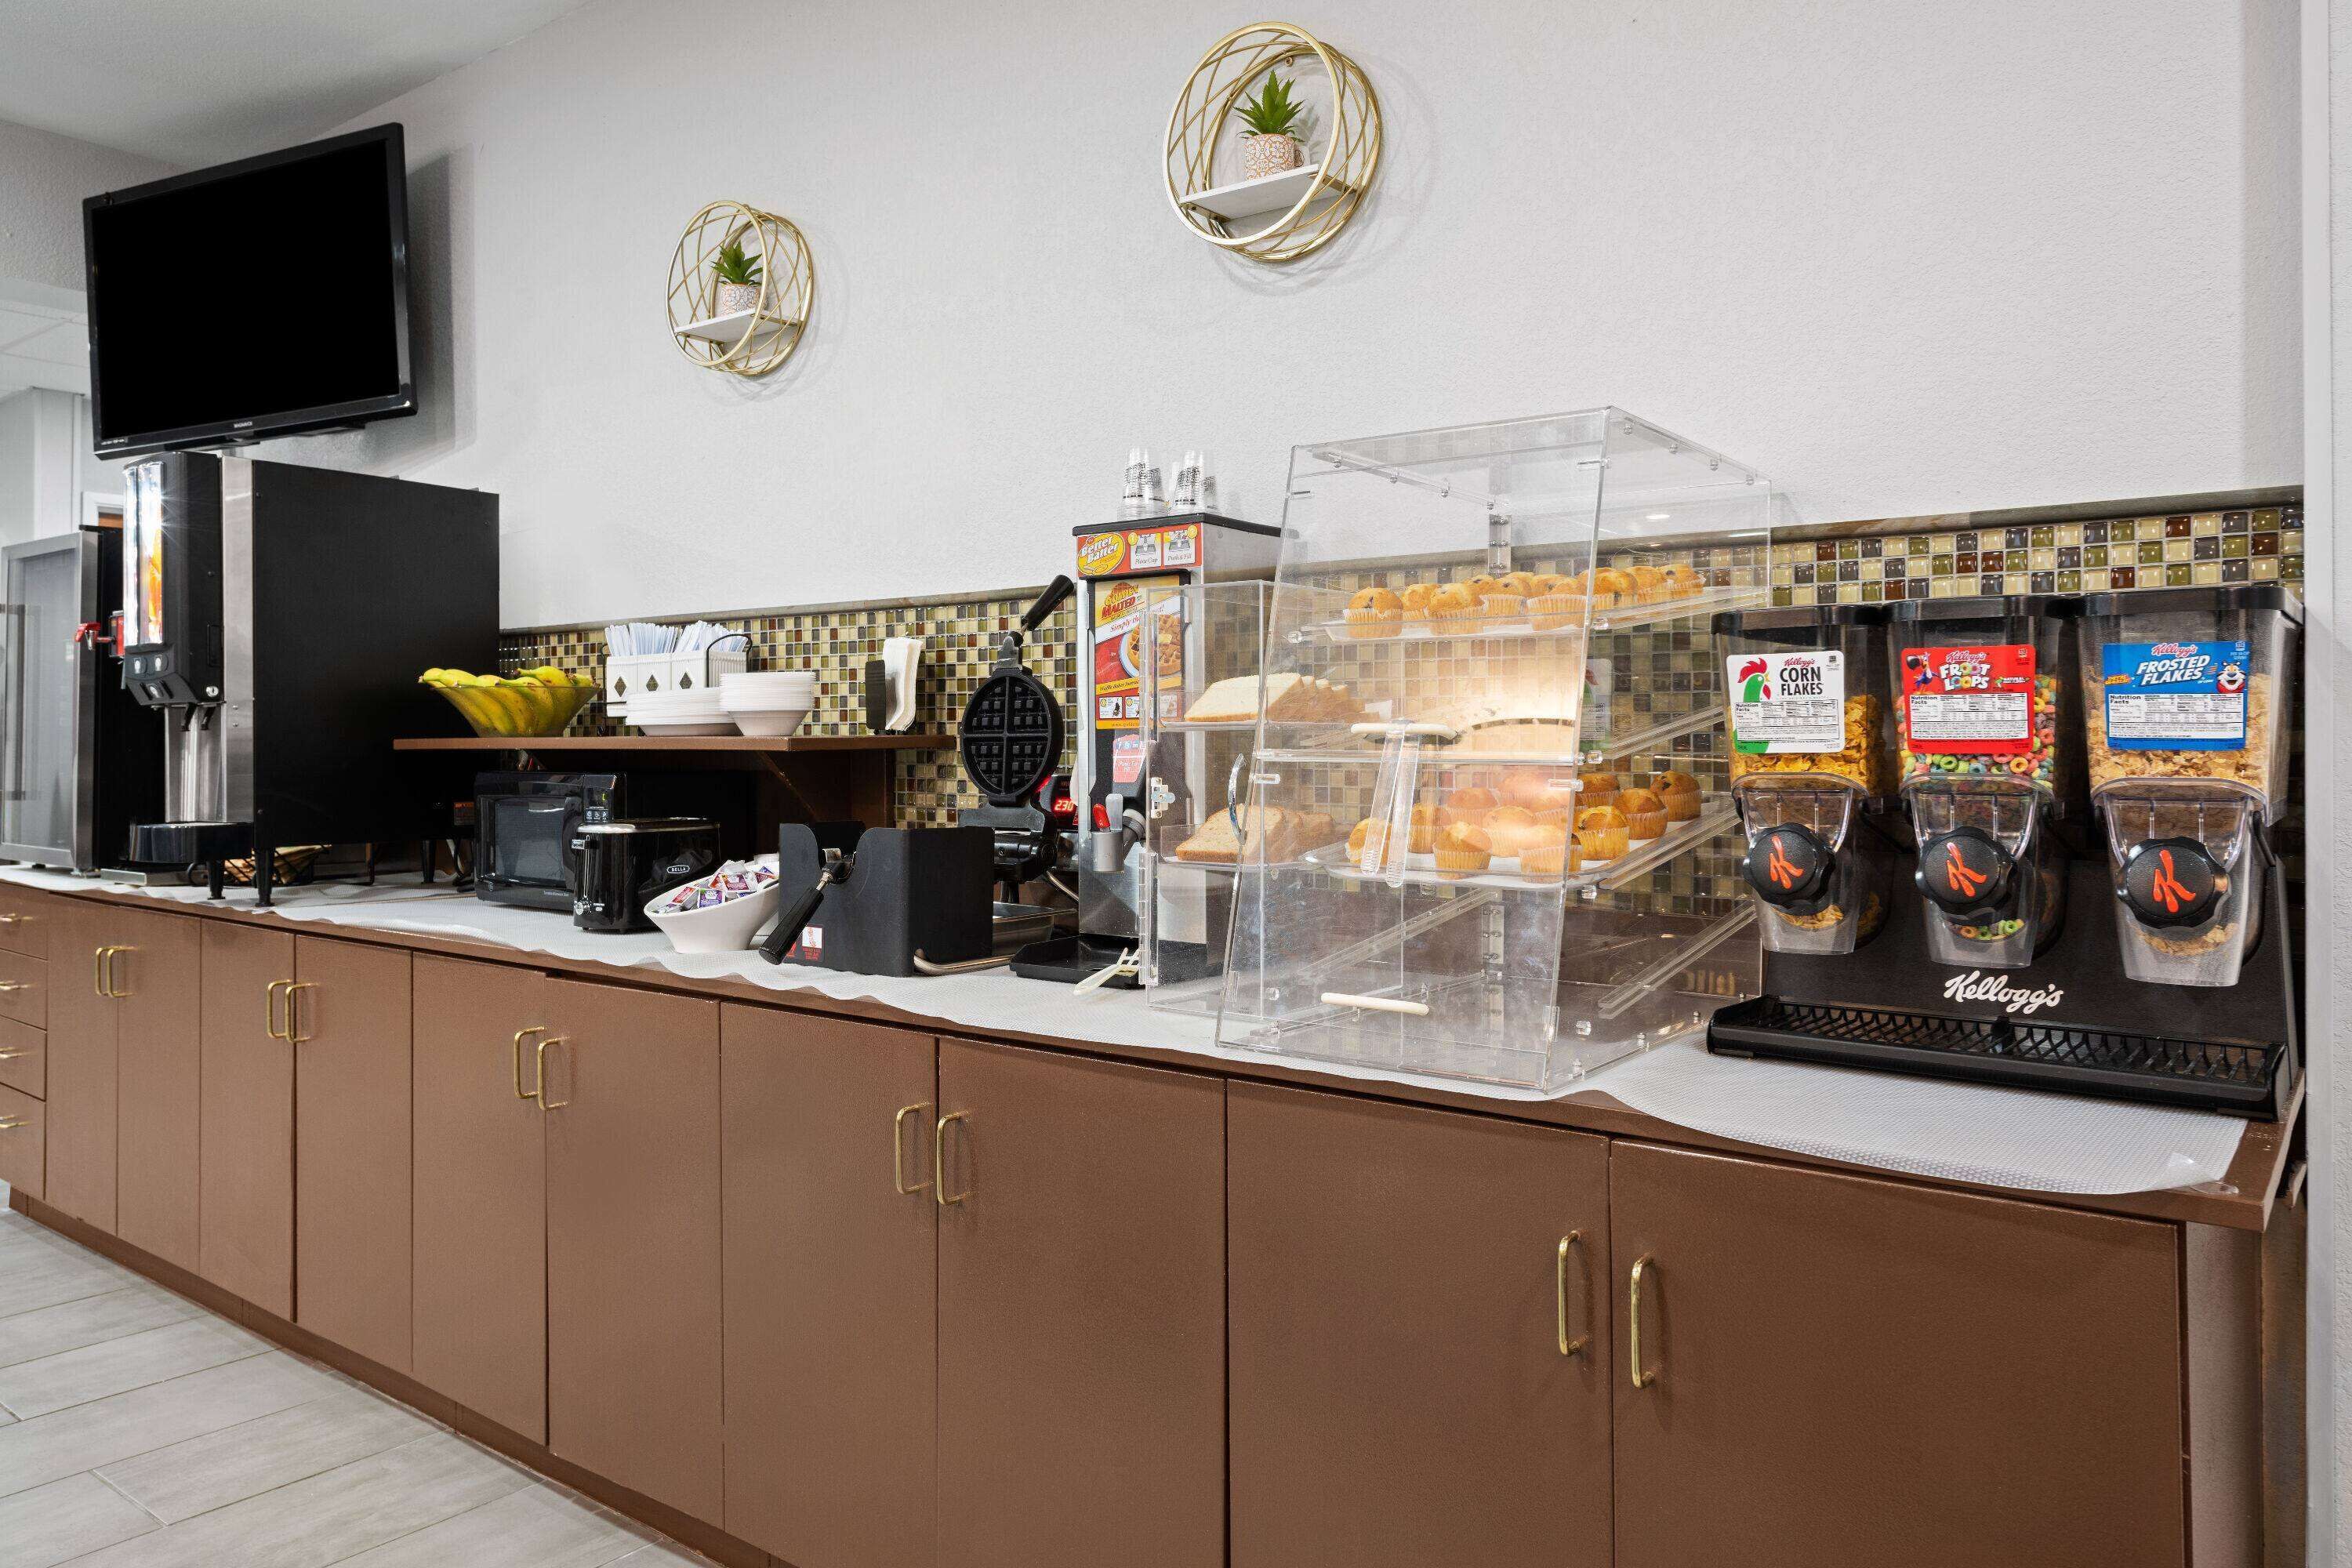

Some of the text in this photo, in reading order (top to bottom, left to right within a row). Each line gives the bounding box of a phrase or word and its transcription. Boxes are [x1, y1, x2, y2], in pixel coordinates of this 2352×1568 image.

[1105, 584, 1139, 606] GOLDEN
[1102, 597, 1136, 619] MALTED
[1110, 619, 1131, 633] Simply
[1946, 651, 1987, 663] Kellogg's
[2151, 642, 2198, 657] Kellogg's
[1784, 657, 1817, 668] Kellogg's
[2135, 655, 2211, 676] FROSTED
[1780, 666, 1821, 682] CORN
[1938, 662, 1991, 679] FROOT
[2140, 667, 2204, 686] FLAKES
[1780, 682, 1823, 696] FLAKES
[1944, 676, 1991, 691] LOOPS
[1054, 800, 1074, 811] 230
[1944, 970, 2064, 1014] Kellogg's
